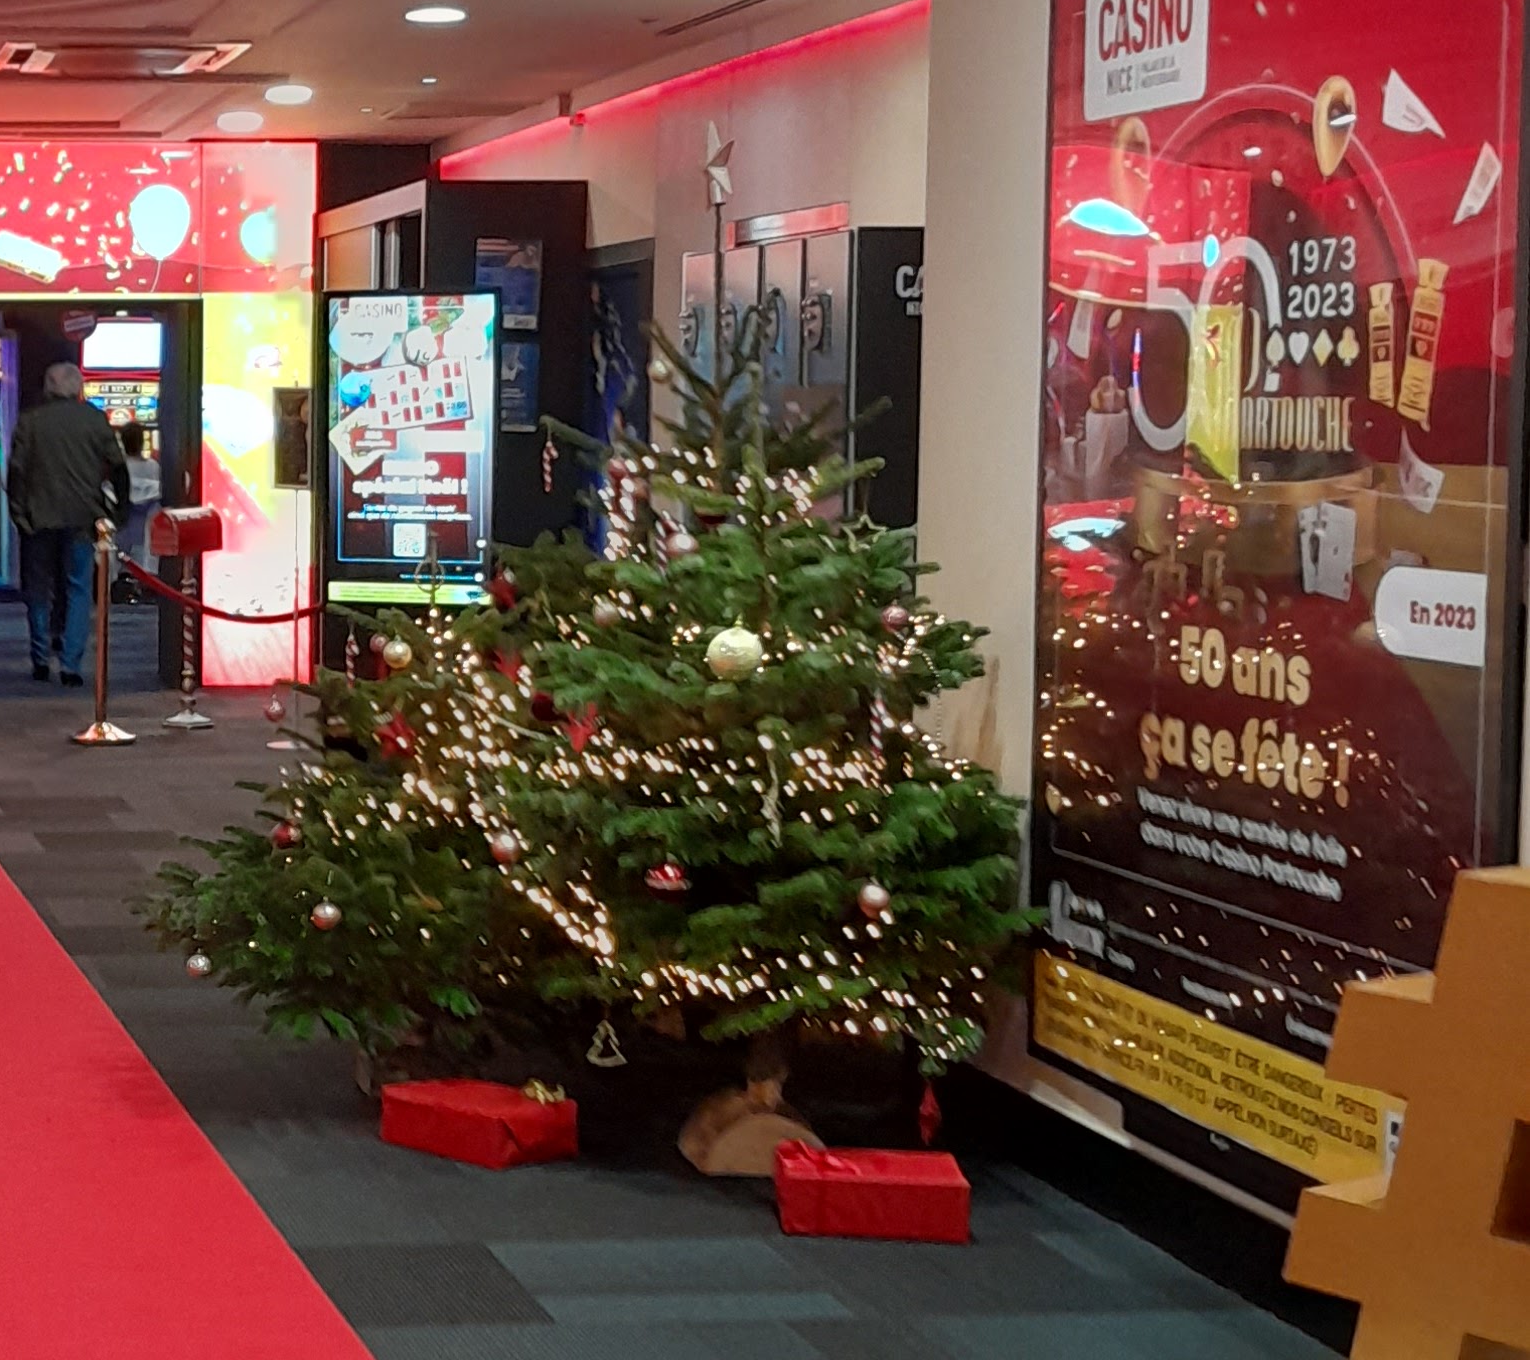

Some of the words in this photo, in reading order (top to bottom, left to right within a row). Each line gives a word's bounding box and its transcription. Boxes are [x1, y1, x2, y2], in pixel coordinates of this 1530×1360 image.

[1106, 64, 1133, 96] NICE
[1288, 235, 1358, 276] 1973
[354, 302, 403, 319] CASINO
[1287, 282, 1356, 321] 2023
[1410, 600, 1430, 625] En
[1434, 602, 1476, 631] 2023
[1180, 624, 1227, 688] 50
[1231, 646, 1312, 706] ans
[1139, 711, 1188, 780] ça
[1190, 723, 1236, 778] se
[1240, 717, 1326, 799] fête
[1334, 738, 1351, 809] !
